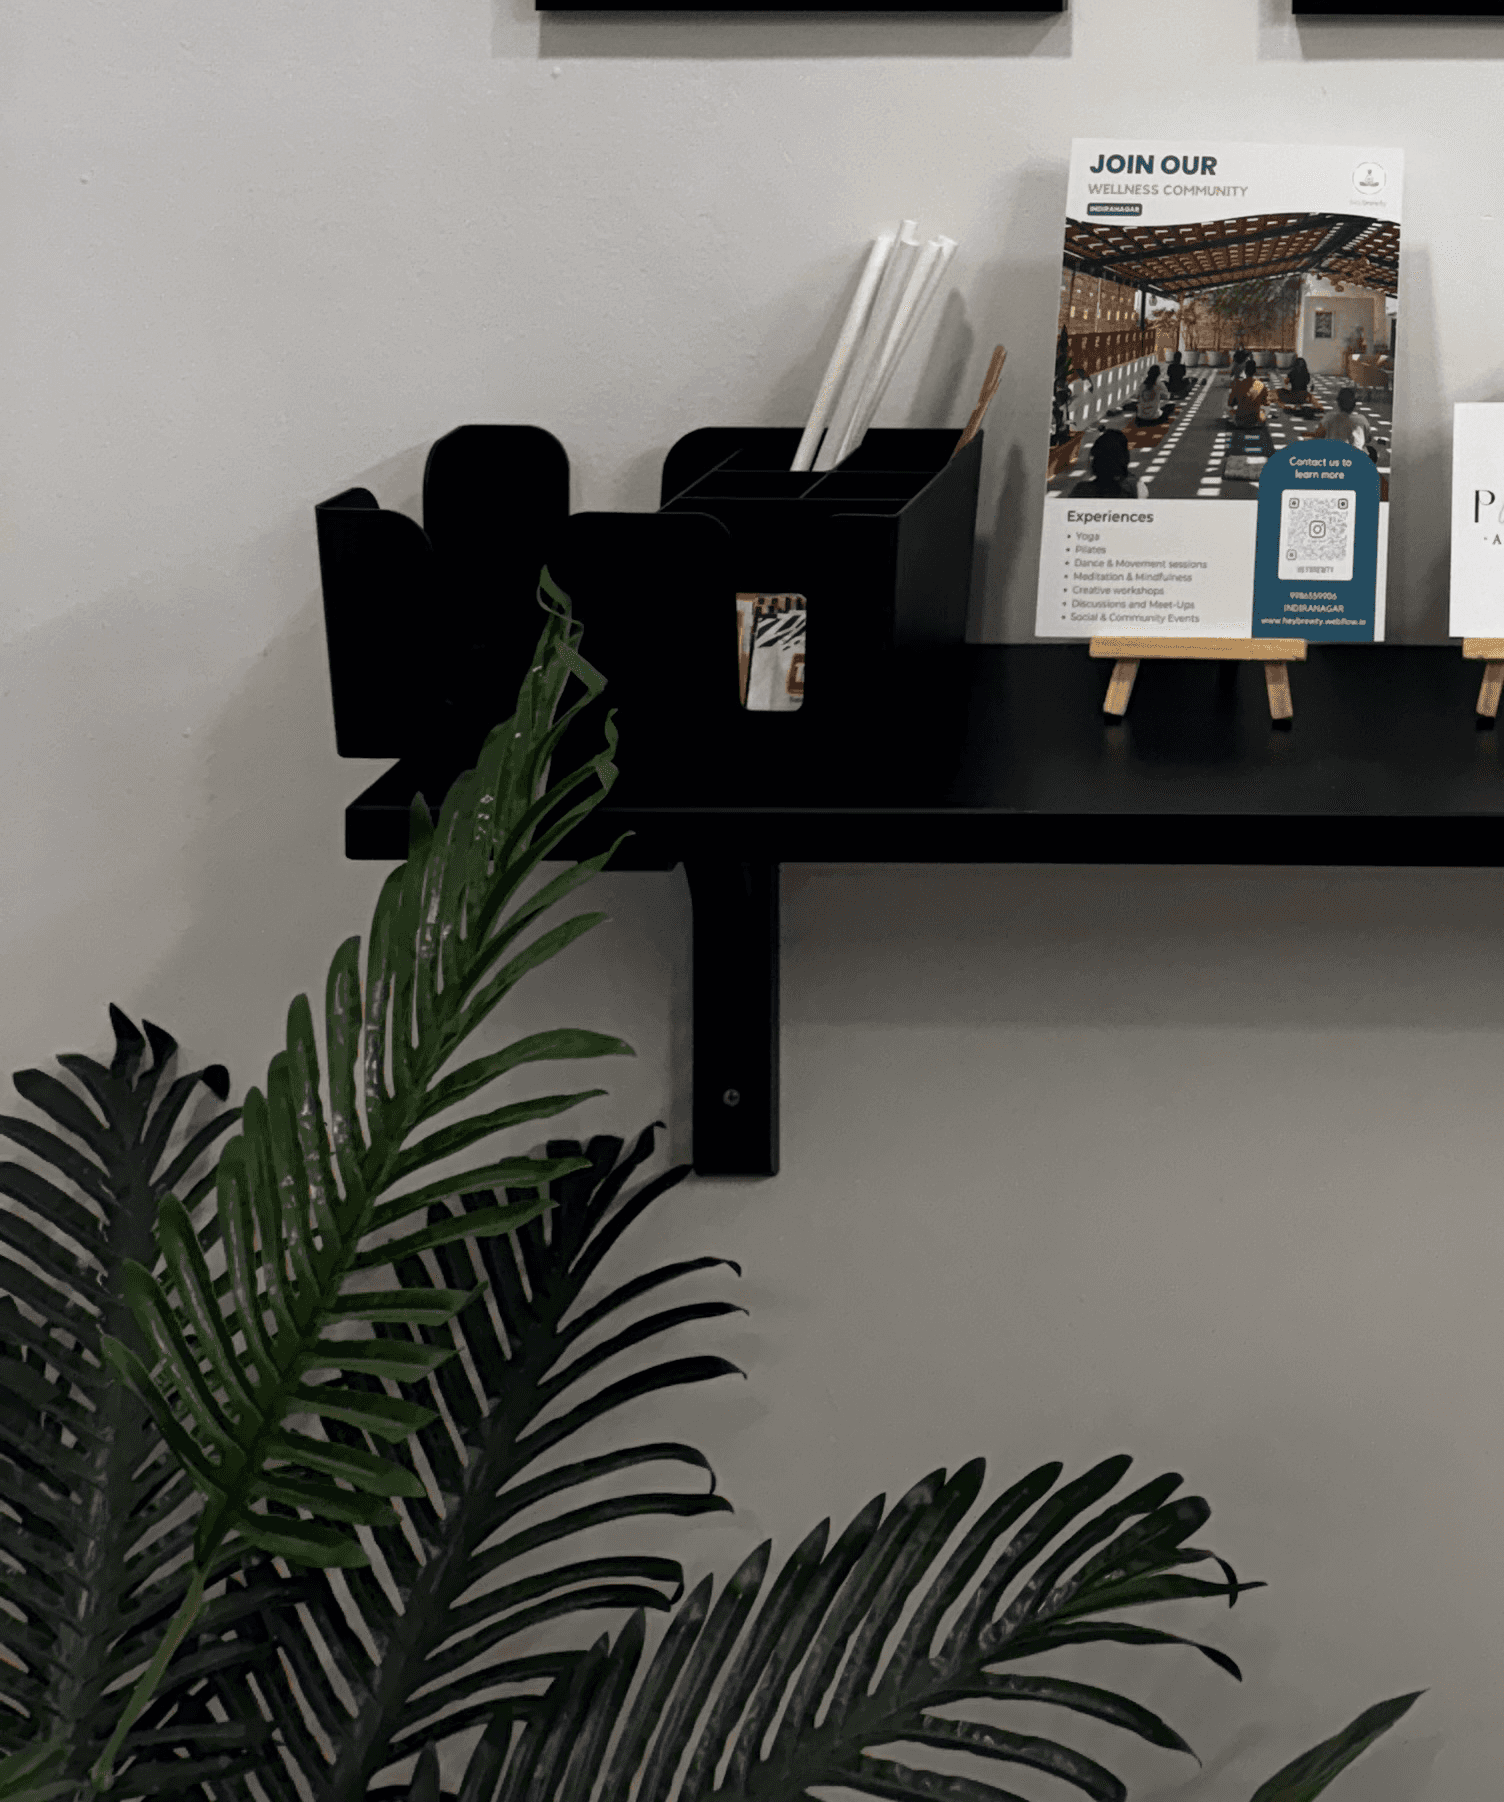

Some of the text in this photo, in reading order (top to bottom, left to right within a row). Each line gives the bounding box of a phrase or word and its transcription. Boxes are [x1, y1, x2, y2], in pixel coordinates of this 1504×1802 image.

[1089, 154, 1218, 176] JOIN OUR
[1088, 183, 1249, 197] WELLNESS COMMUNITY
[1288, 456, 1353, 467] Contact us to
[1295, 469, 1345, 479] learn more
[1067, 510, 1154, 525] Experiences
[1075, 532, 1100, 542] Yoga
[1075, 545, 1107, 554] Pilates
[1074, 558, 1208, 569] Dance & Movement sessions
[1073, 572, 1192, 582] Meditation & Mindfulness
[1072, 586, 1165, 596] Creative workshops
[1071, 599, 1195, 611] Discussions and Meet-Ups
[1283, 604, 1345, 613] INDIRANAGAR
[1070, 612, 1200, 624] Social & Community Events
